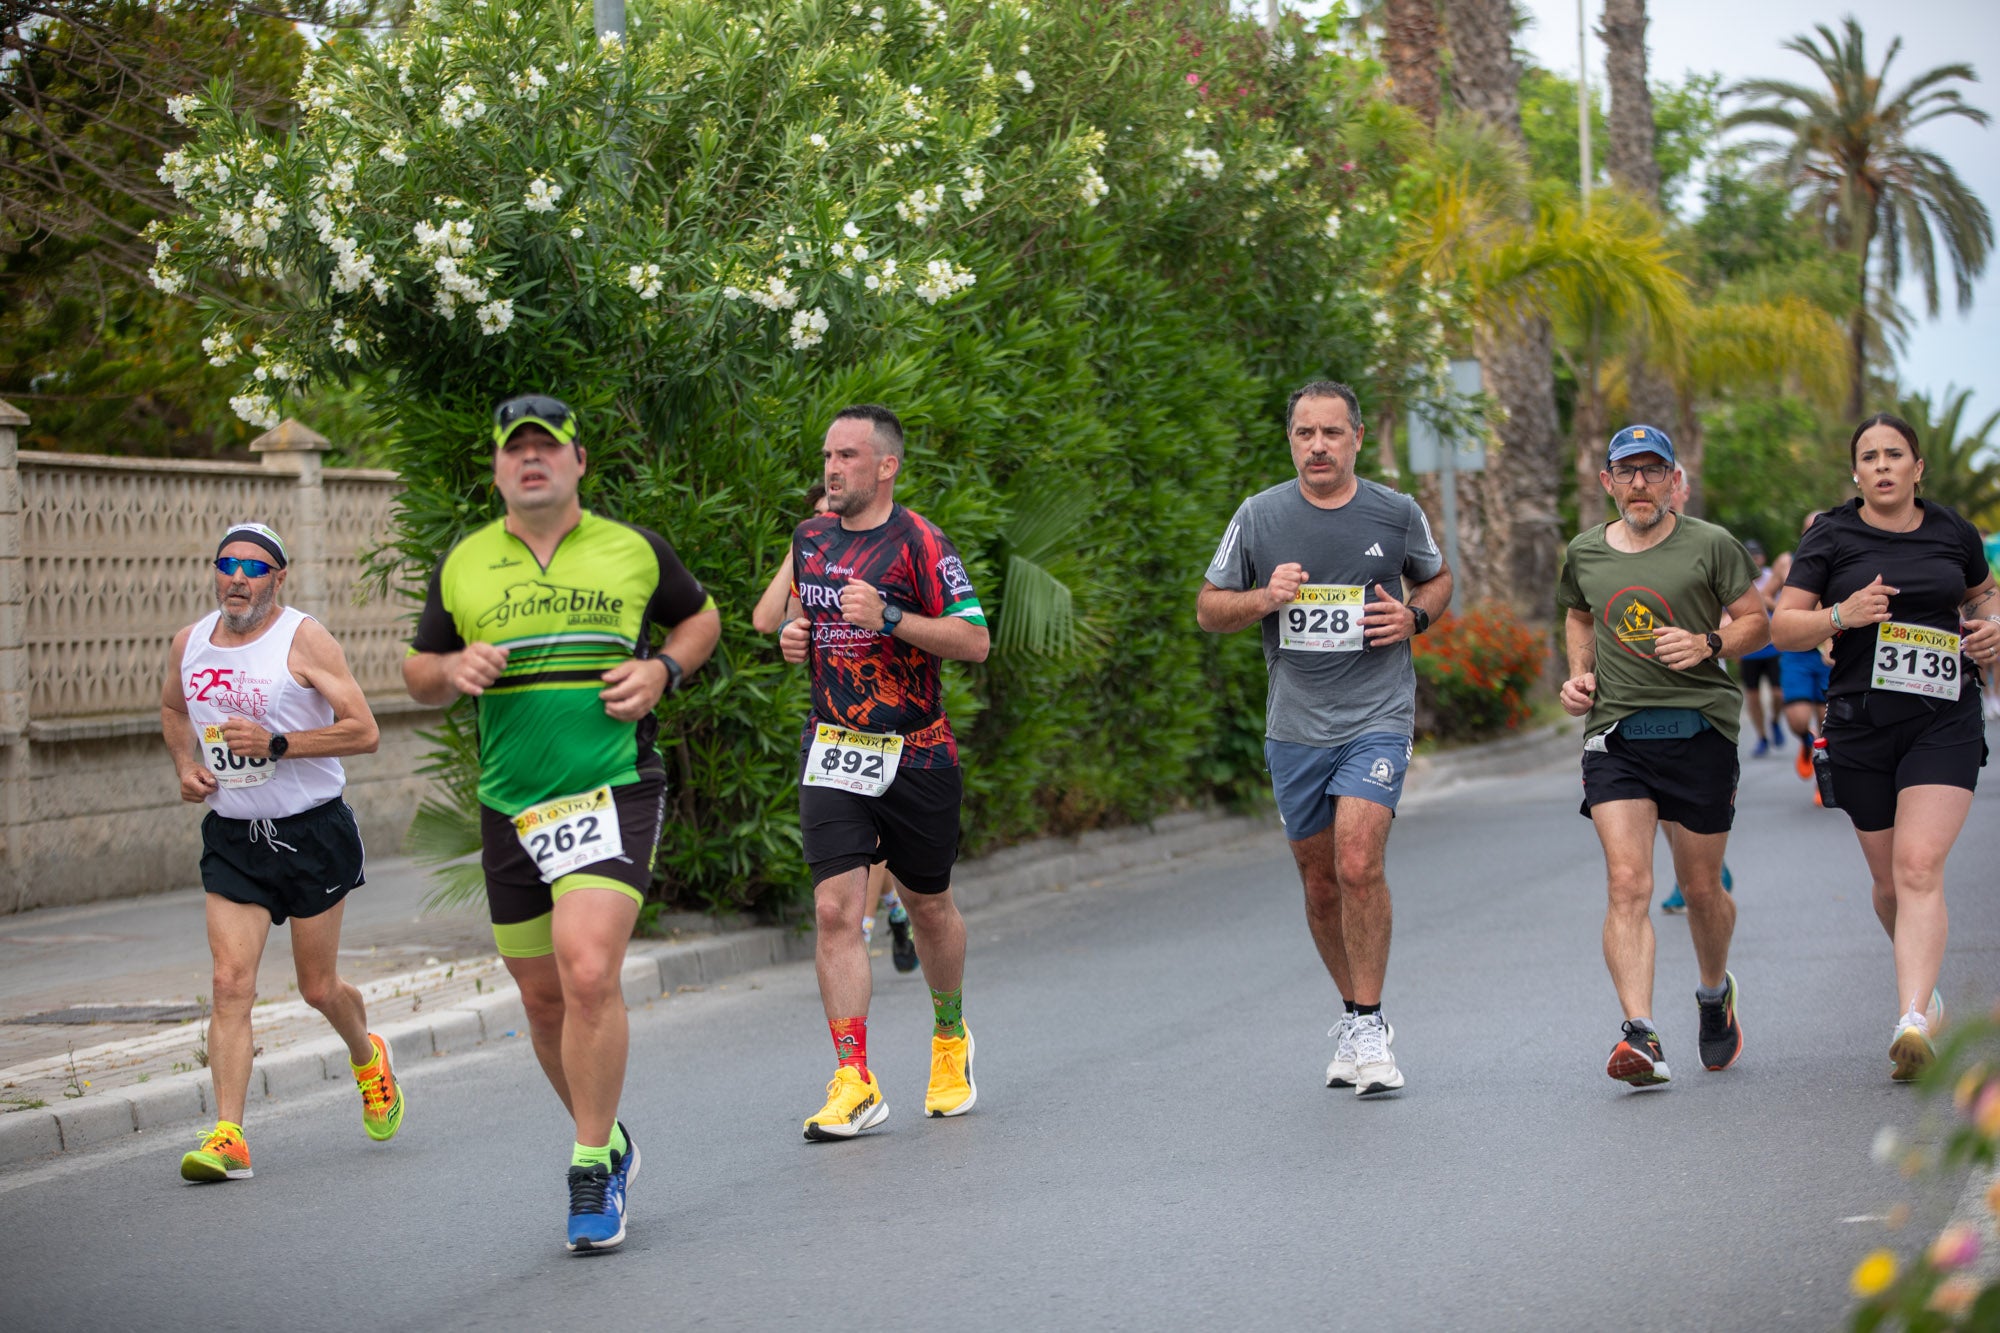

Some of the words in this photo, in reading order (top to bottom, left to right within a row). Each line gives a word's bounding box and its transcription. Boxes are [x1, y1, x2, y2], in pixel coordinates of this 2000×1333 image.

[1288, 608, 1350, 634] 928
[1892, 627, 1907, 639] 38
[1878, 646, 1957, 682] 3139
[185, 668, 234, 701] 525
[206, 728, 217, 738] 38
[1622, 721, 1679, 735] naked
[821, 748, 884, 779] 892
[525, 812, 538, 829] 38
[530, 815, 602, 863] 262
